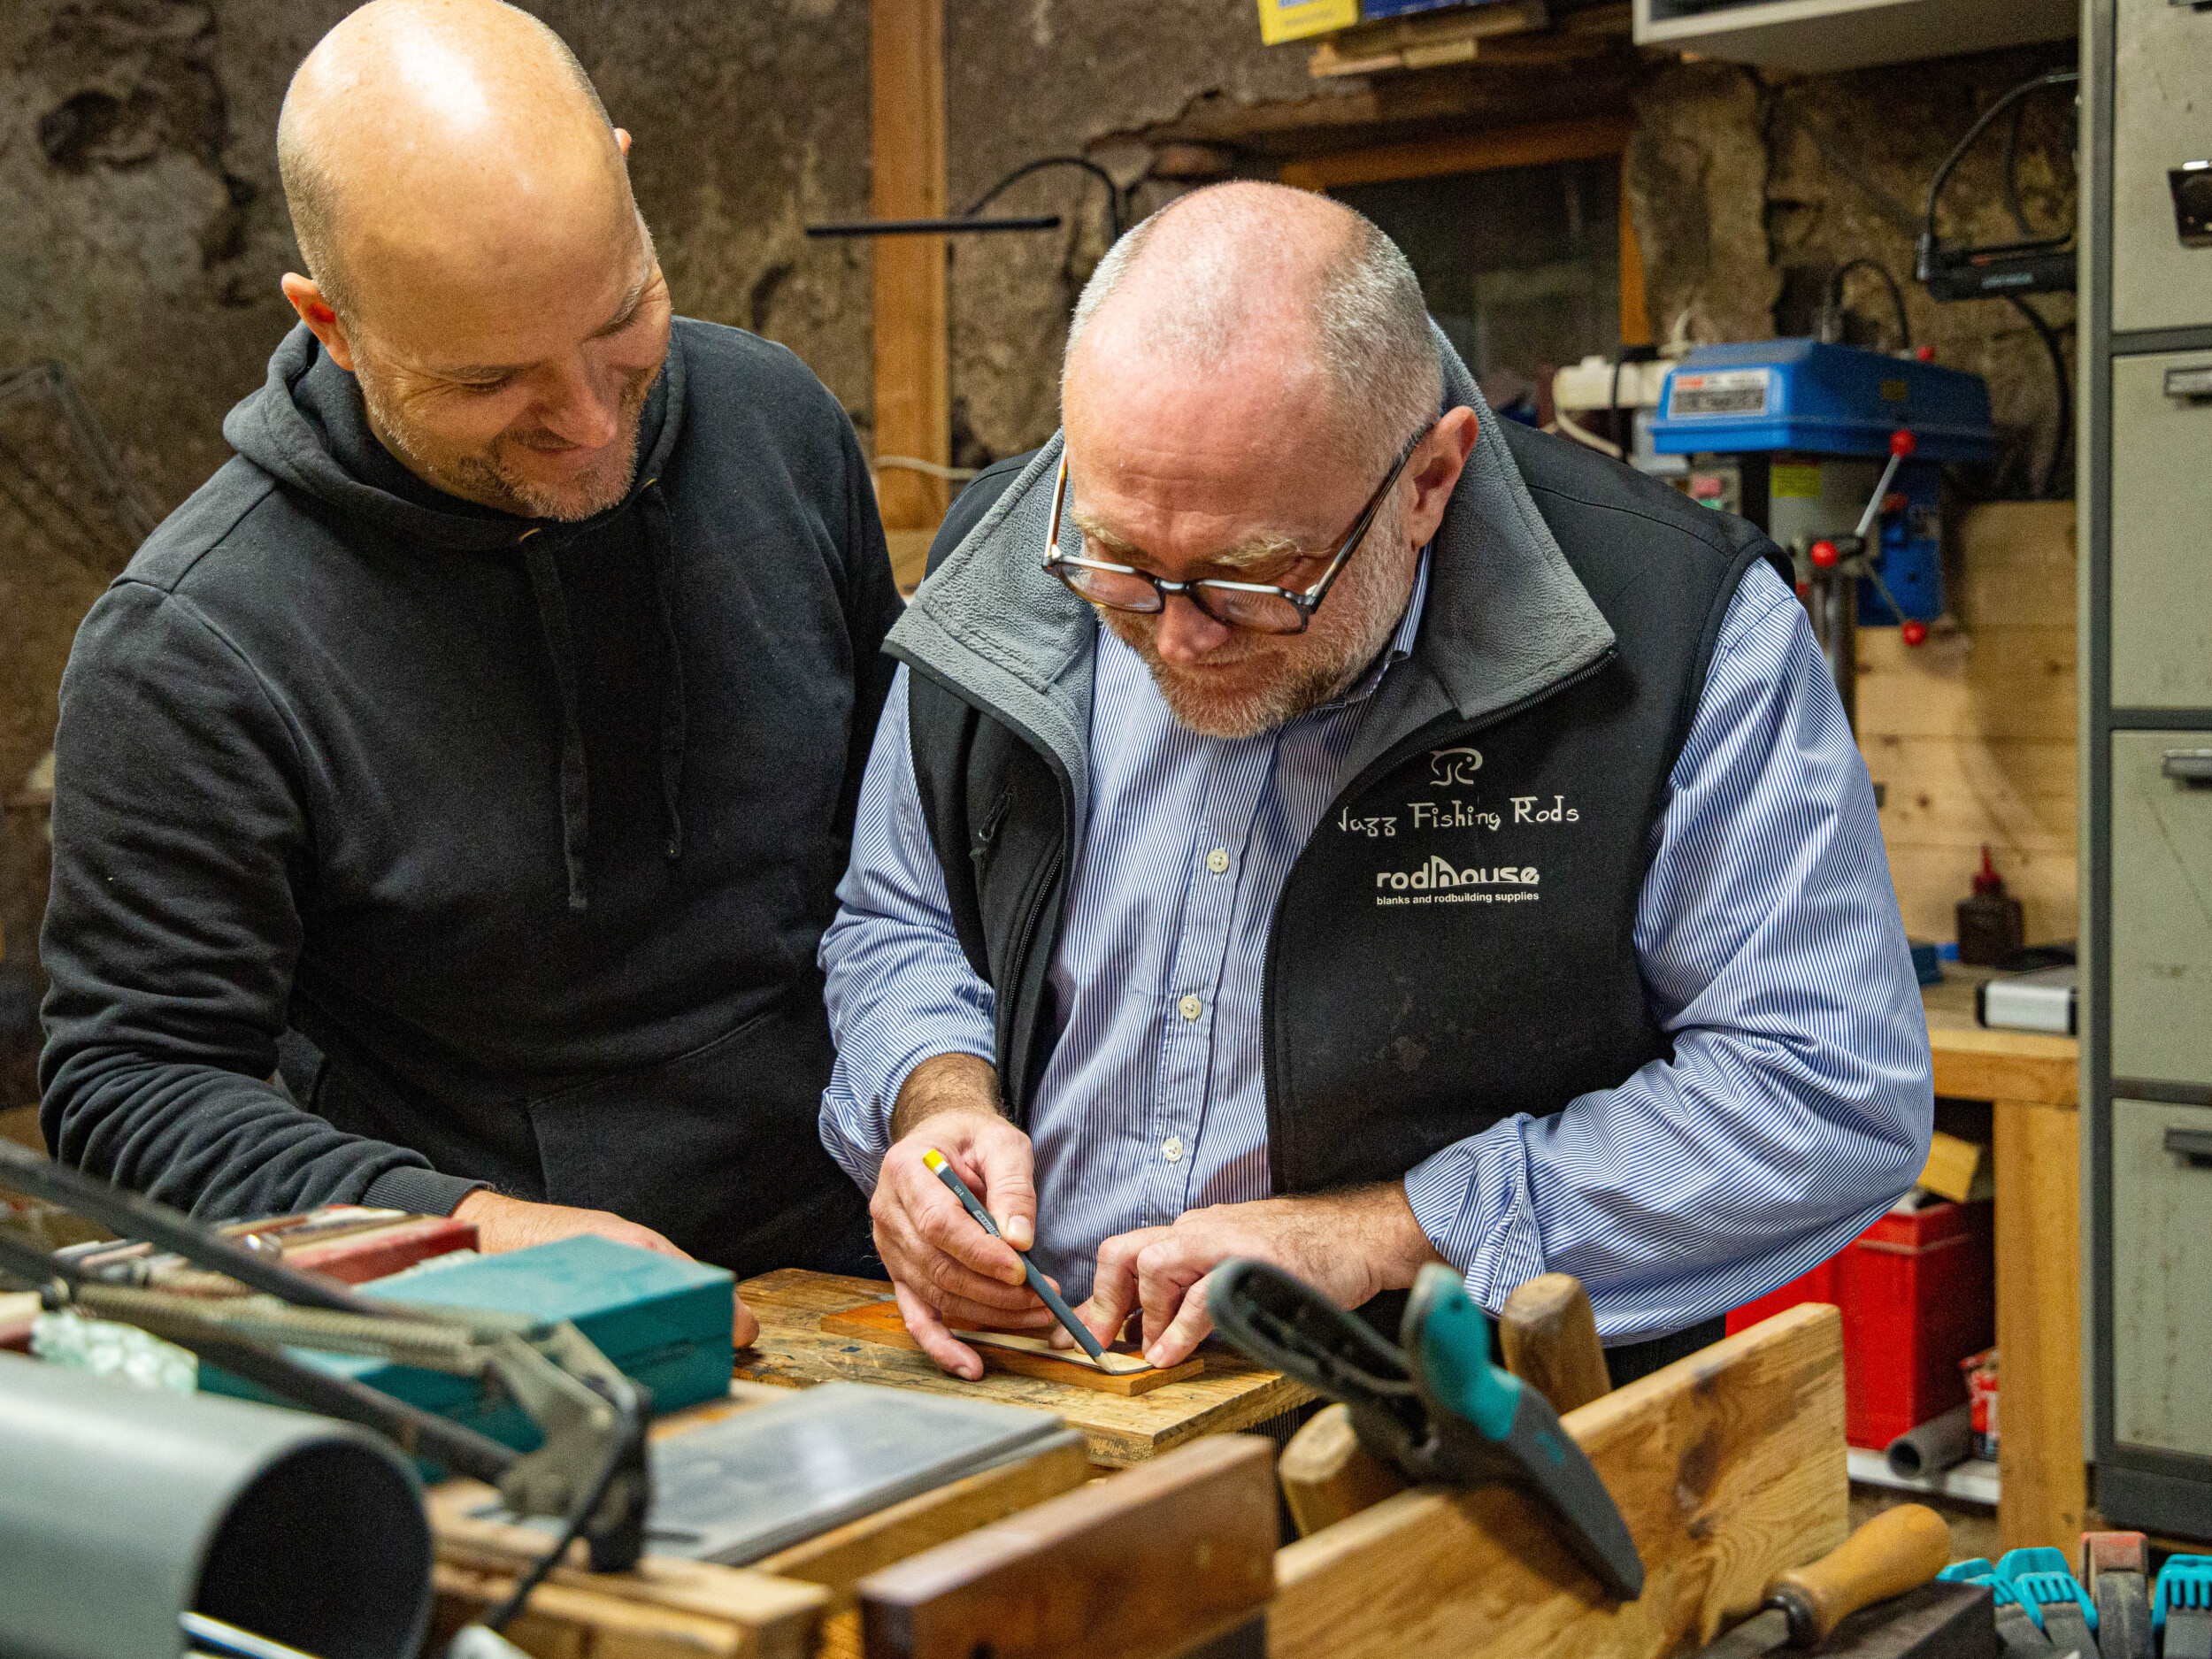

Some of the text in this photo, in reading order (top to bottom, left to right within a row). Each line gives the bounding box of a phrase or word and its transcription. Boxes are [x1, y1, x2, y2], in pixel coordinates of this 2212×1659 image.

[1338, 795, 1579, 837] Jazz Fishing Rods
[1377, 855, 1540, 889] rodhouse
[1376, 891, 1540, 905] blanks and rodbuilding supplies
